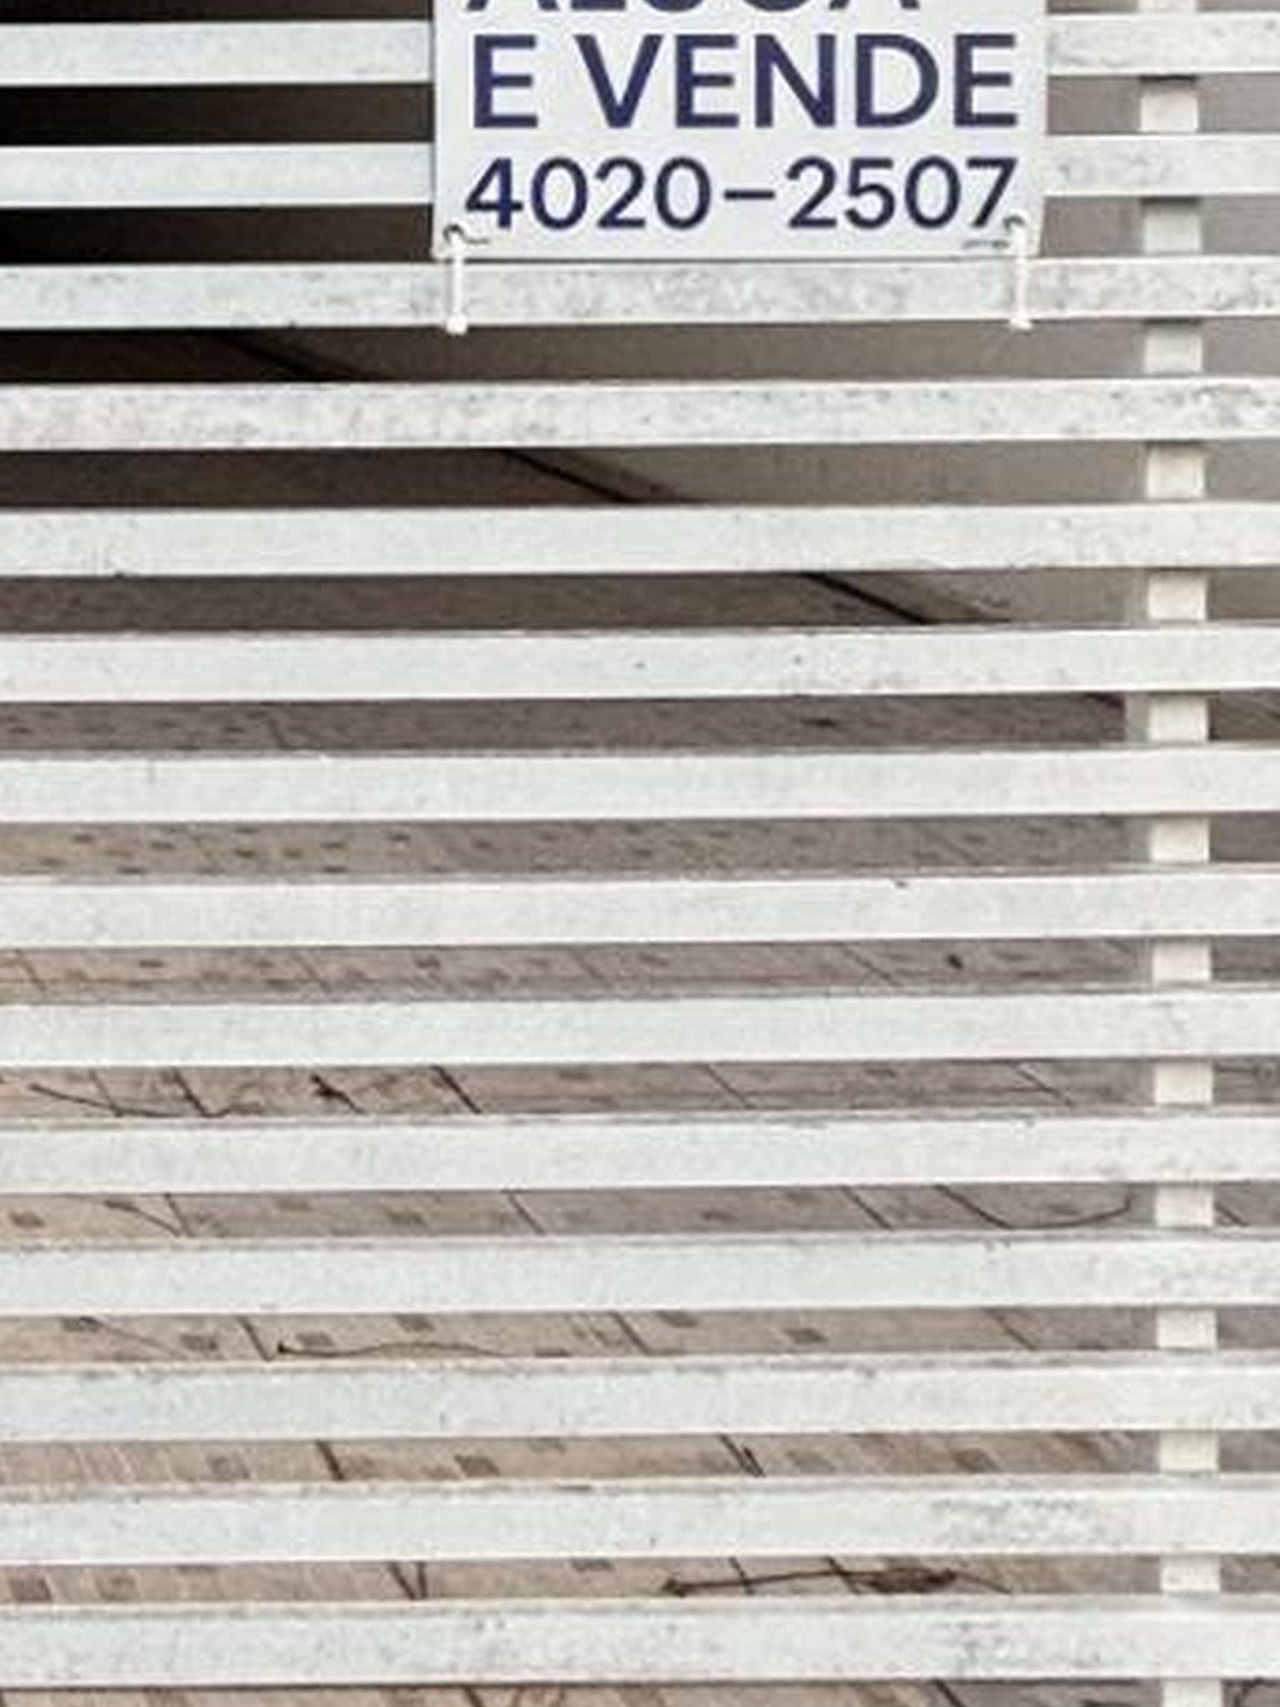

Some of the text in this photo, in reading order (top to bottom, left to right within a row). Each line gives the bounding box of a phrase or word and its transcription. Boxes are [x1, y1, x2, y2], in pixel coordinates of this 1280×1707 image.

[473, 33, 1018, 129] E VENDE
[465, 157, 1017, 230] 4020-2507
